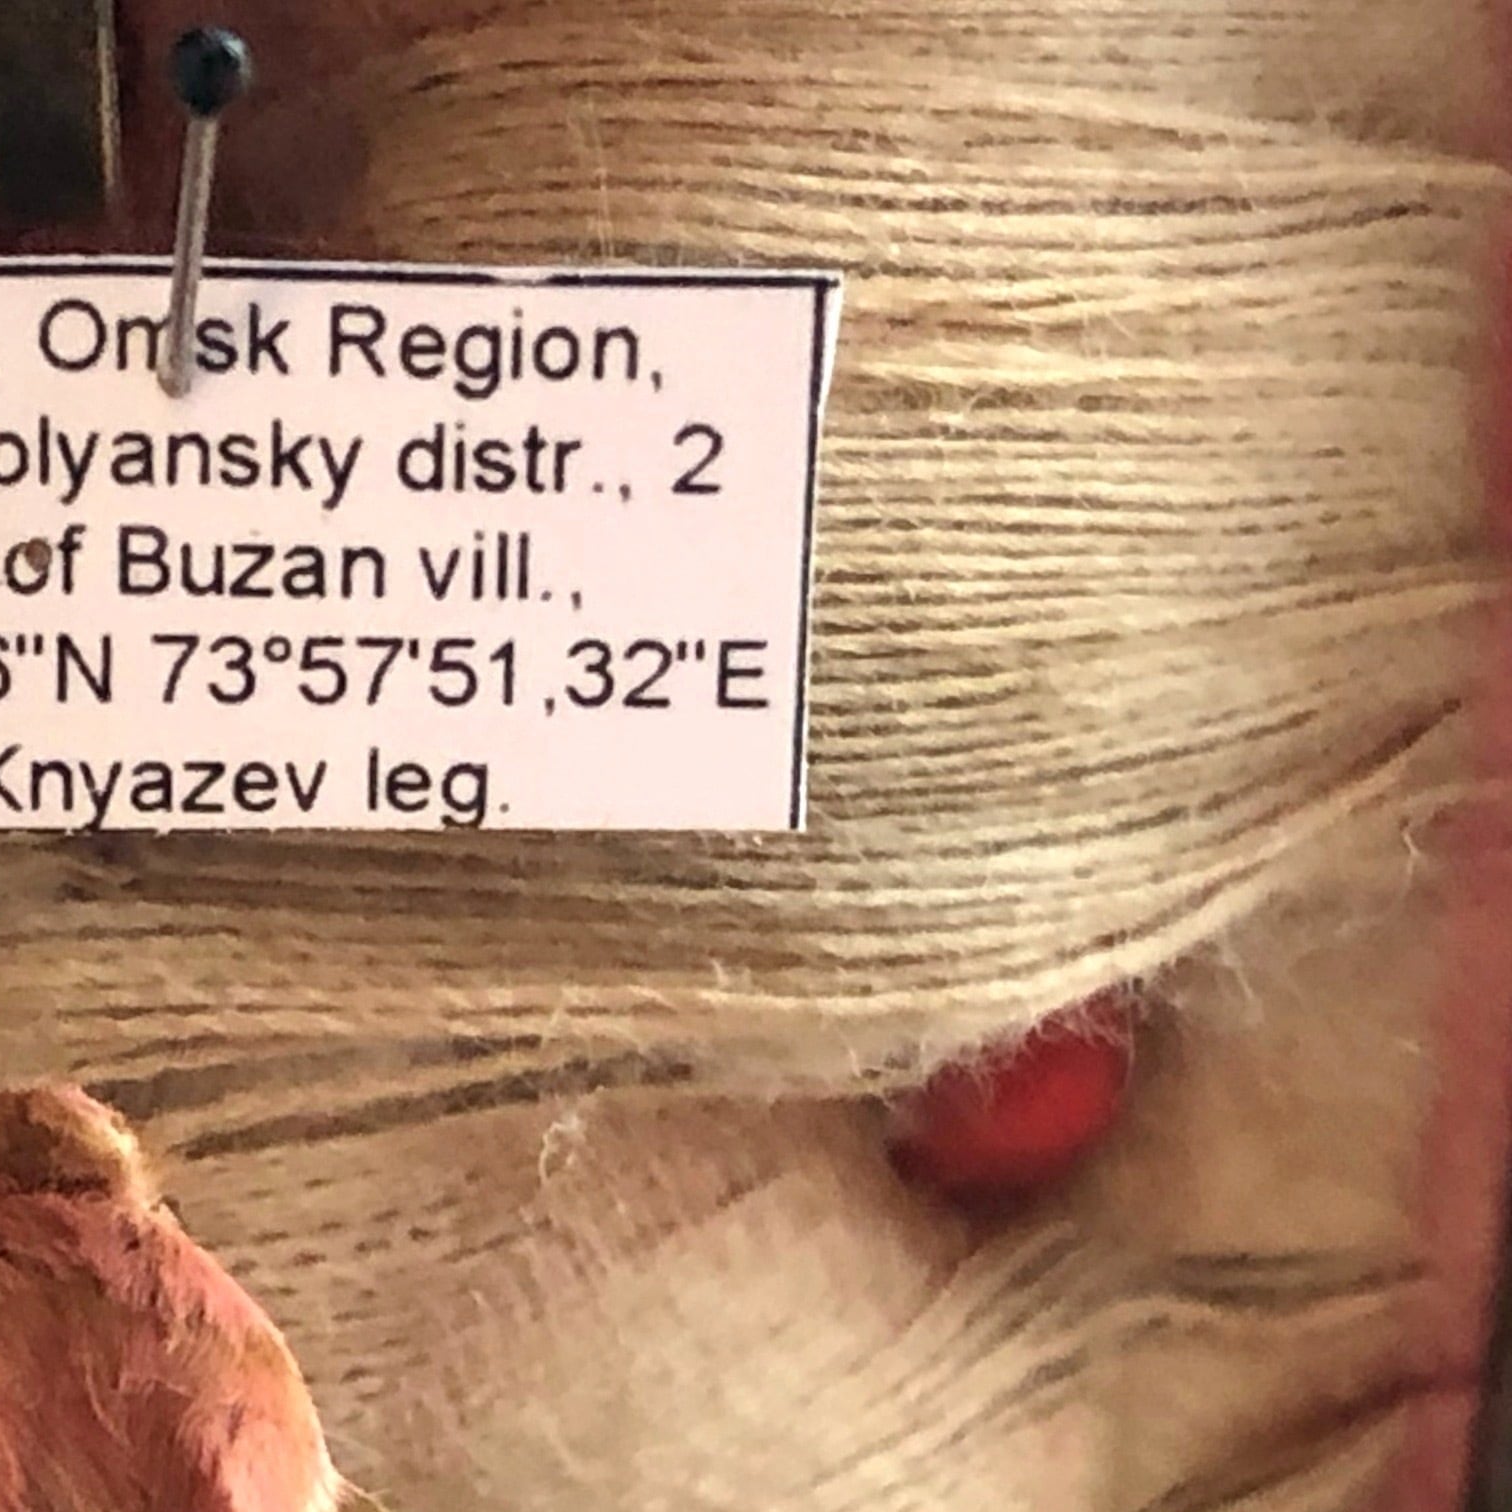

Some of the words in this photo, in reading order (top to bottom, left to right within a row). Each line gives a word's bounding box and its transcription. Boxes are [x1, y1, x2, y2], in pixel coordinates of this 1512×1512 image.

[38, 299, 290, 375] Omsk
[329, 303, 662, 400] Region,
[397, 423, 632, 500] distr.,
[672, 423, 723, 495] 2
[3, 524, 86, 596] of
[118, 525, 386, 599] Buzan
[419, 532, 583, 608] vill.,
[368, 748, 511, 827] leg.
